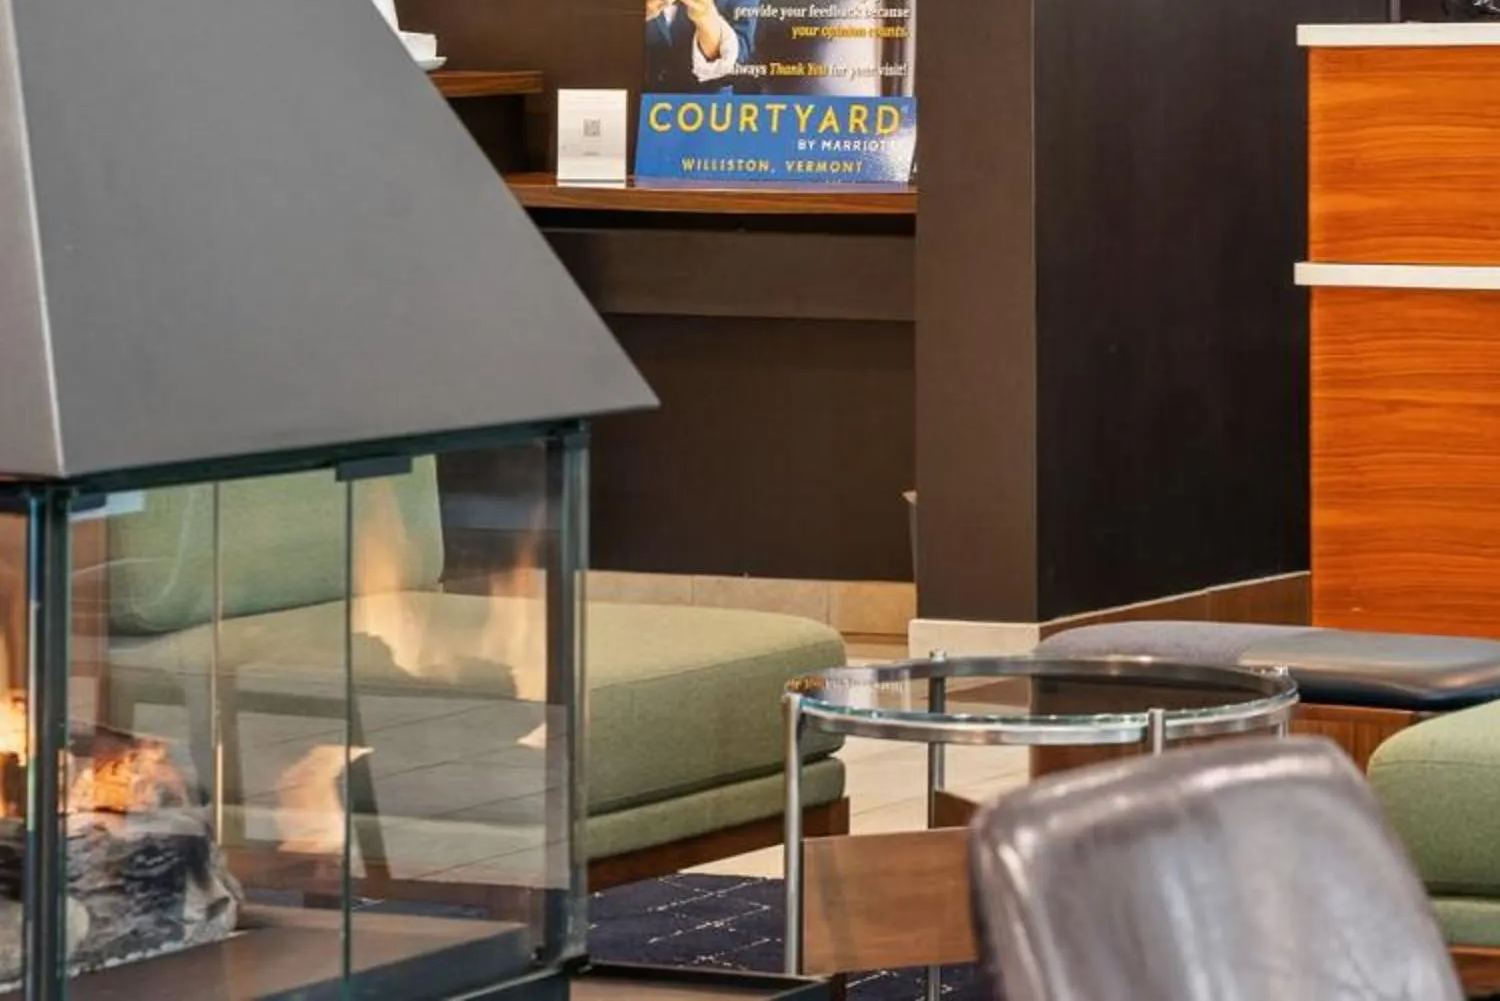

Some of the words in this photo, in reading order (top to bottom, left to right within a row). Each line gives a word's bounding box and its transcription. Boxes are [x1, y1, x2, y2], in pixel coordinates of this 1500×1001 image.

[733, 5, 778, 20] provide
[779, 6, 806, 21] your
[791, 26, 819, 40] your
[731, 63, 767, 78] lways
[769, 62, 805, 76] Thank
[807, 62, 829, 76] You
[648, 102, 900, 134] COURTYARD
[797, 139, 816, 150] BY
[680, 158, 777, 174] WILLISTON,
[785, 159, 864, 173] VERMONT
